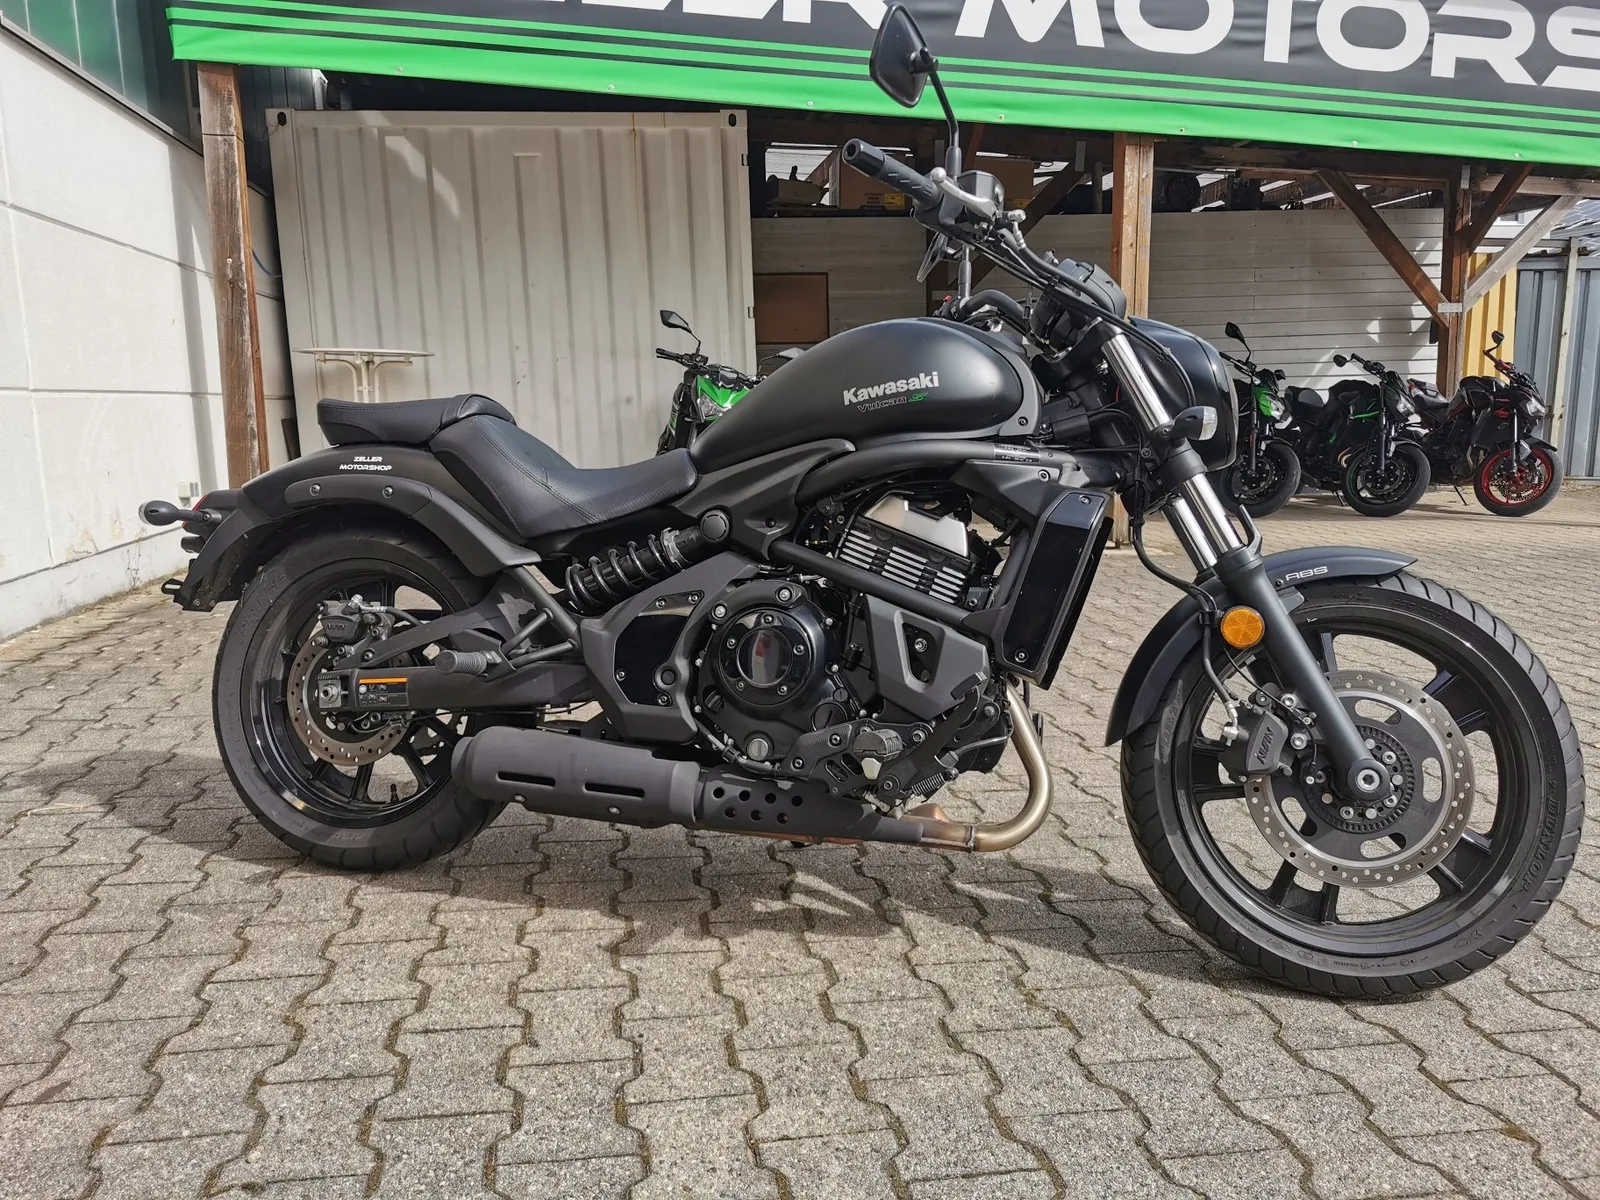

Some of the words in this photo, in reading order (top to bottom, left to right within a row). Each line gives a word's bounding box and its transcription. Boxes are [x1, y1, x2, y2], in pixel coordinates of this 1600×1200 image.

[842, 371, 939, 406] Kawasaki
[1285, 566, 1329, 581] ABS
[1522, 796, 1560, 892] DUNLOP
